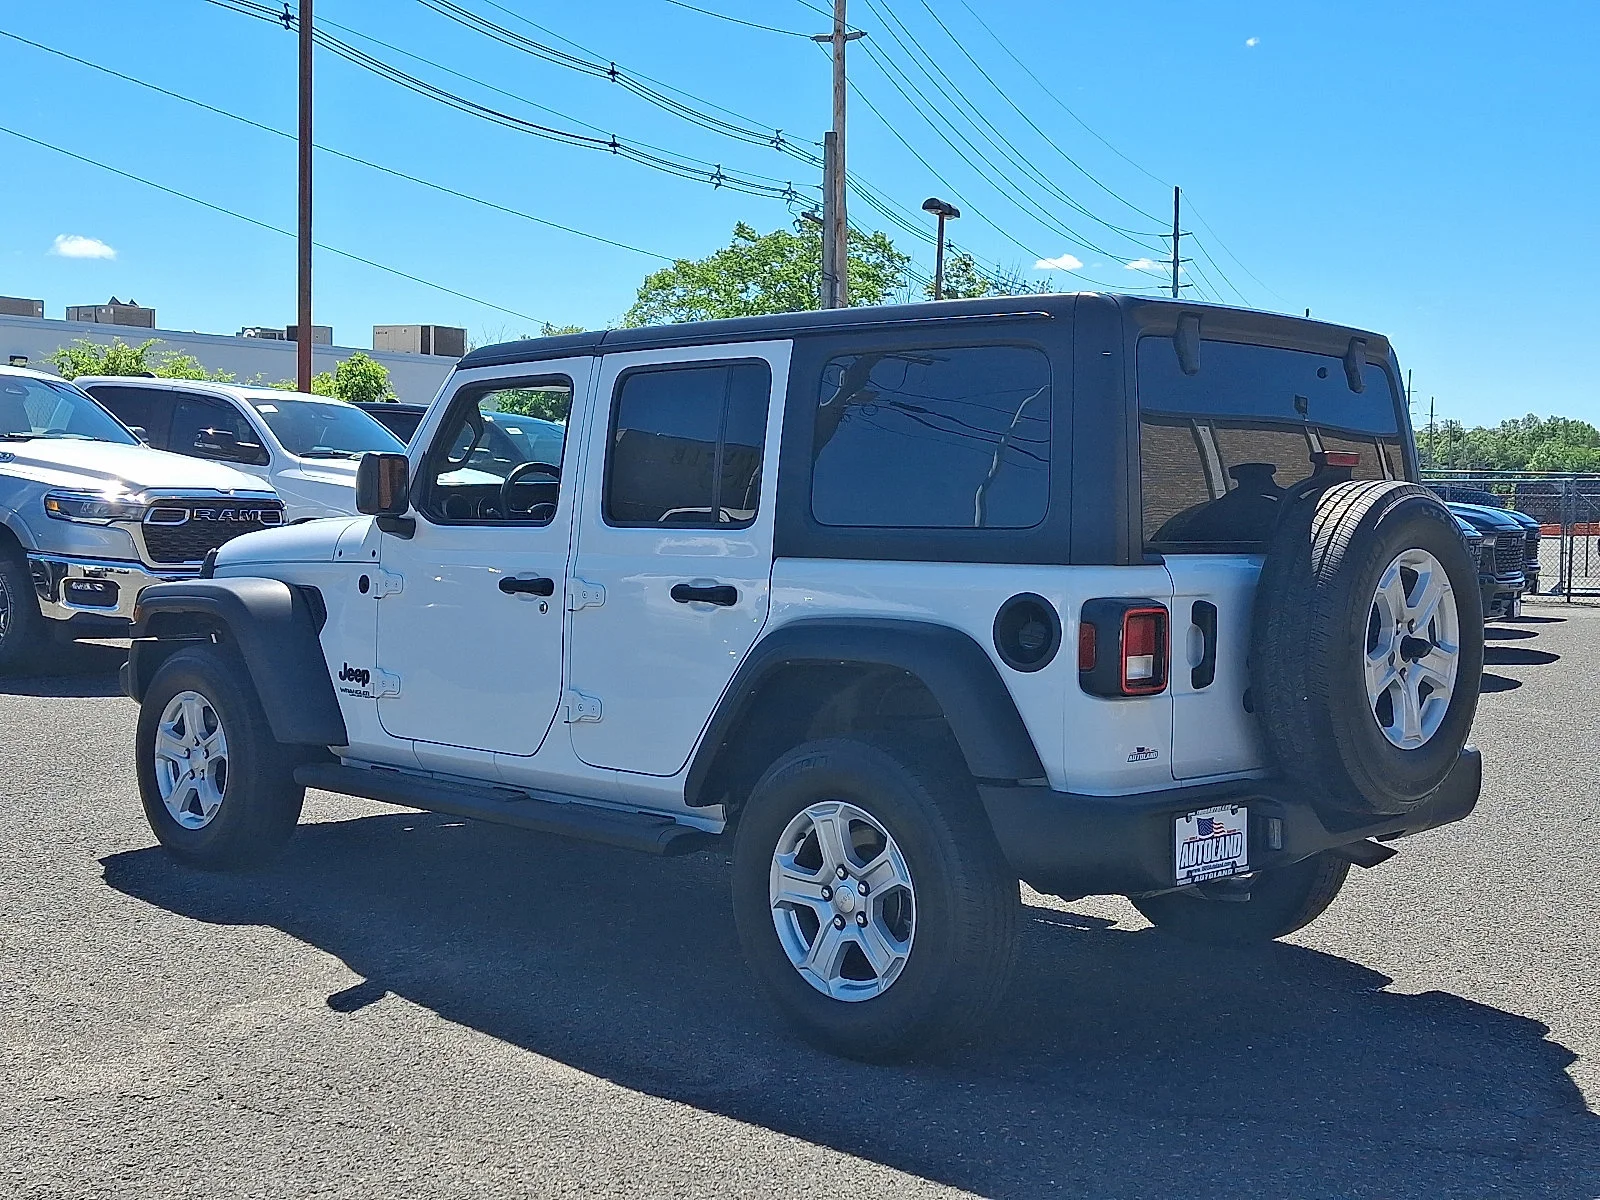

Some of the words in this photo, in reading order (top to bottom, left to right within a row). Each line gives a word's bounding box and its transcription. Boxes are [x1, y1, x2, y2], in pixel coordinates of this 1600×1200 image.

[193, 508, 260, 522] RAM
[338, 661, 370, 688] Jeep
[1178, 832, 1243, 870] AUTOLAND
[1193, 868, 1234, 883] AUTOLAND
